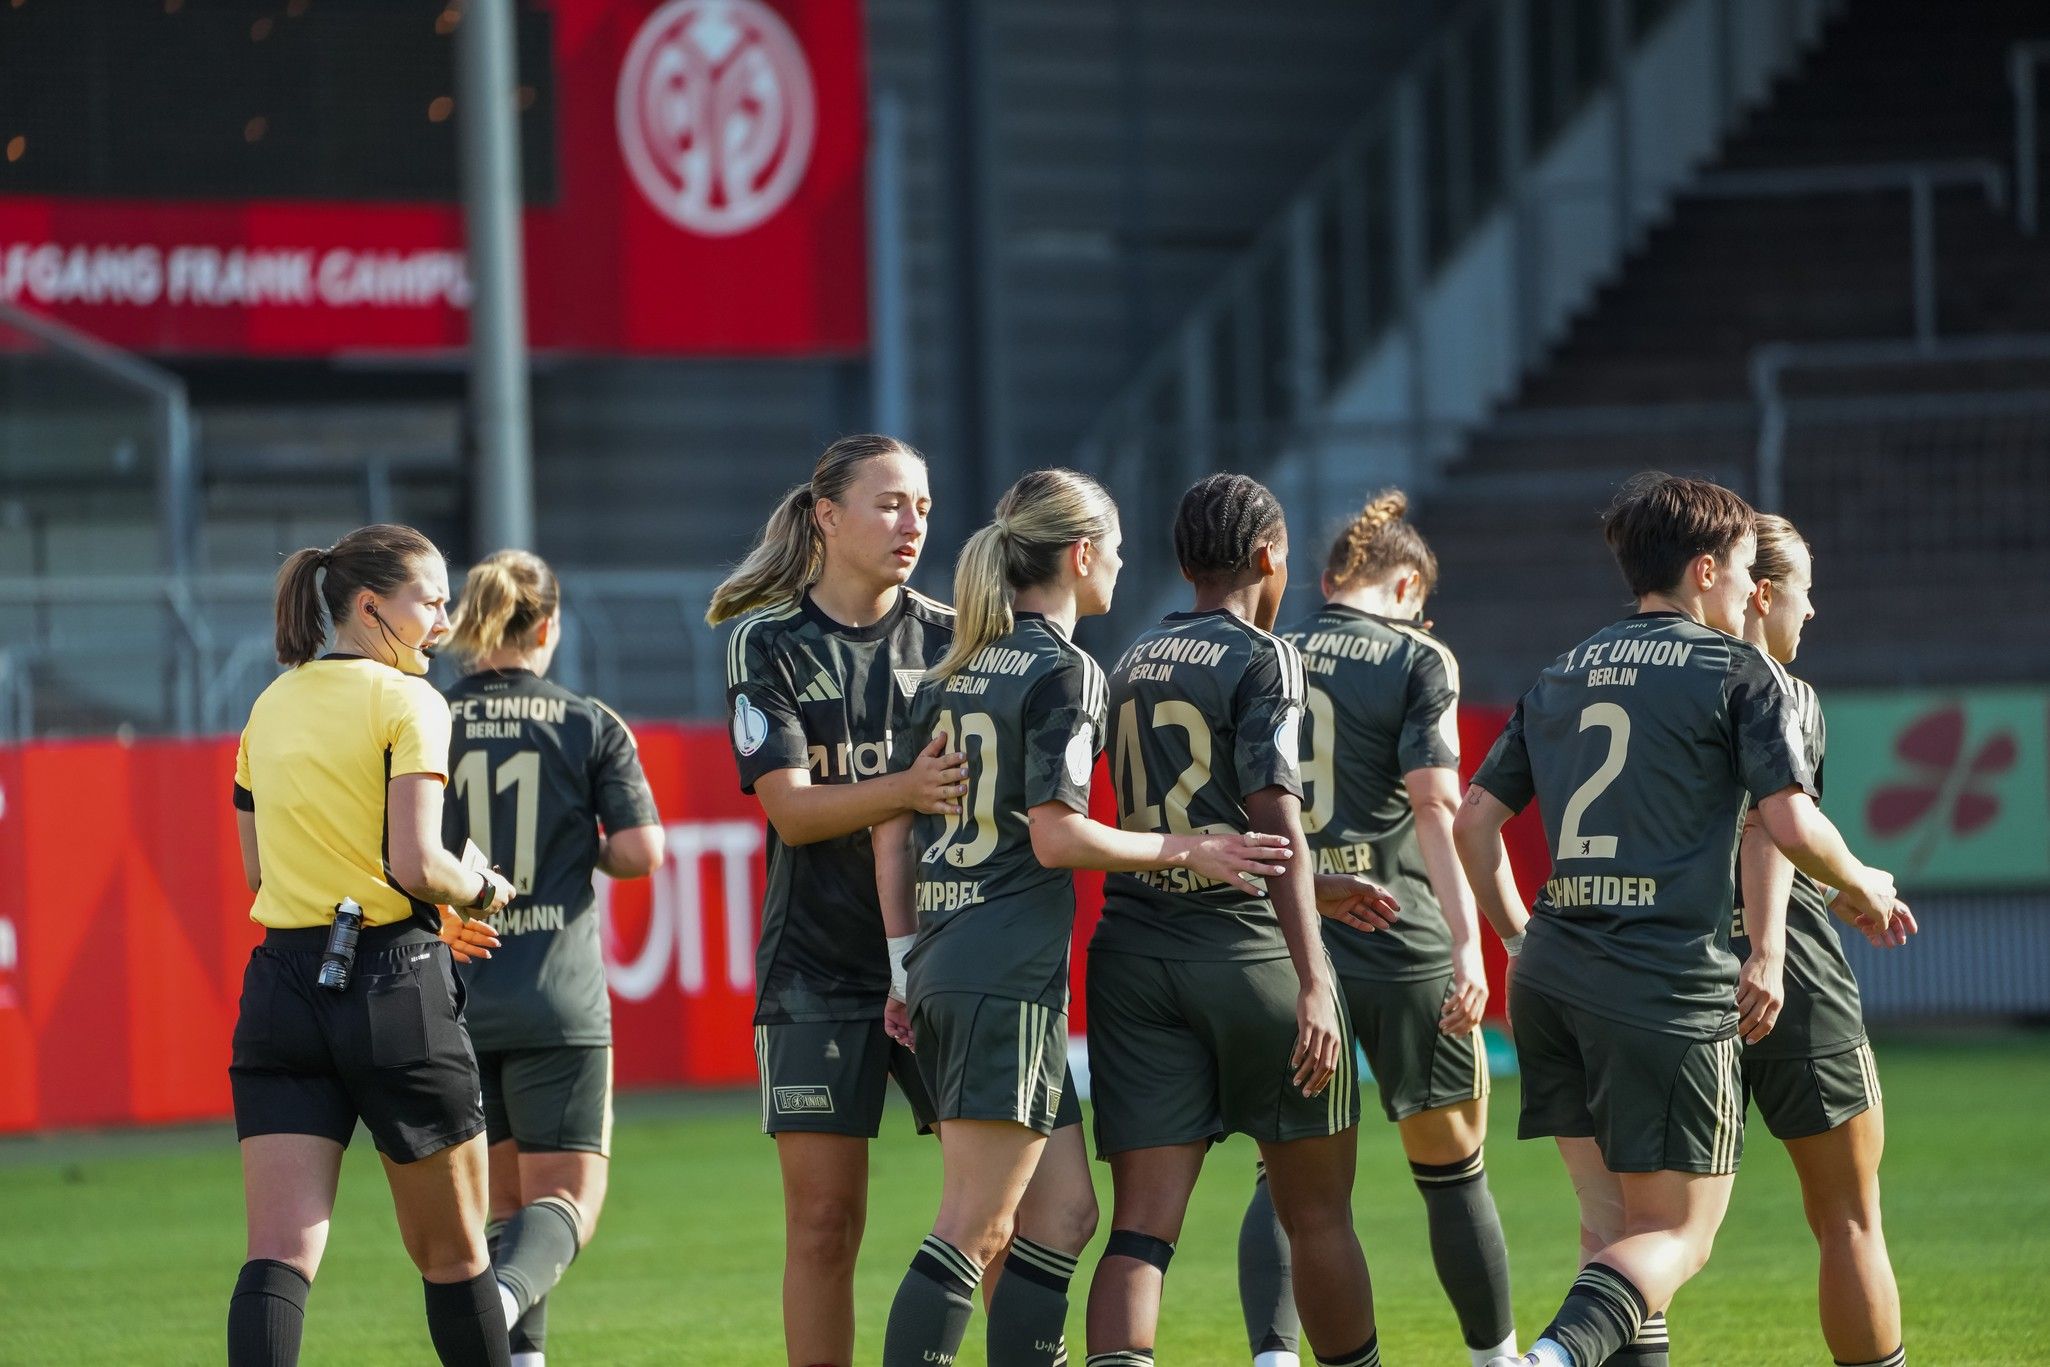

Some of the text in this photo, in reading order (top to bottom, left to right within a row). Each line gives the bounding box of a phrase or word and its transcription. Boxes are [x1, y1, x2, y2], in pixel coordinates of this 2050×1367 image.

[0, 244, 163, 305] FGANG
[968, 647, 1038, 676] UNION
[1126, 640, 1155, 668] FC
[1148, 637, 1229, 667] UNION
[1305, 633, 1389, 666] UNION
[1579, 641, 1610, 669] FC
[1608, 639, 1693, 667] UNION
[945, 674, 990, 695] BERLIN
[1128, 662, 1175, 683] BERLIN
[1587, 667, 1638, 687] BERLIN
[451, 696, 567, 724] FC UNION
[465, 721, 521, 740] BERLIN
[1114, 698, 1242, 836] 42
[1556, 702, 1631, 860] 2
[453, 750, 541, 896] 11
[483, 905, 564, 936] HMANN
